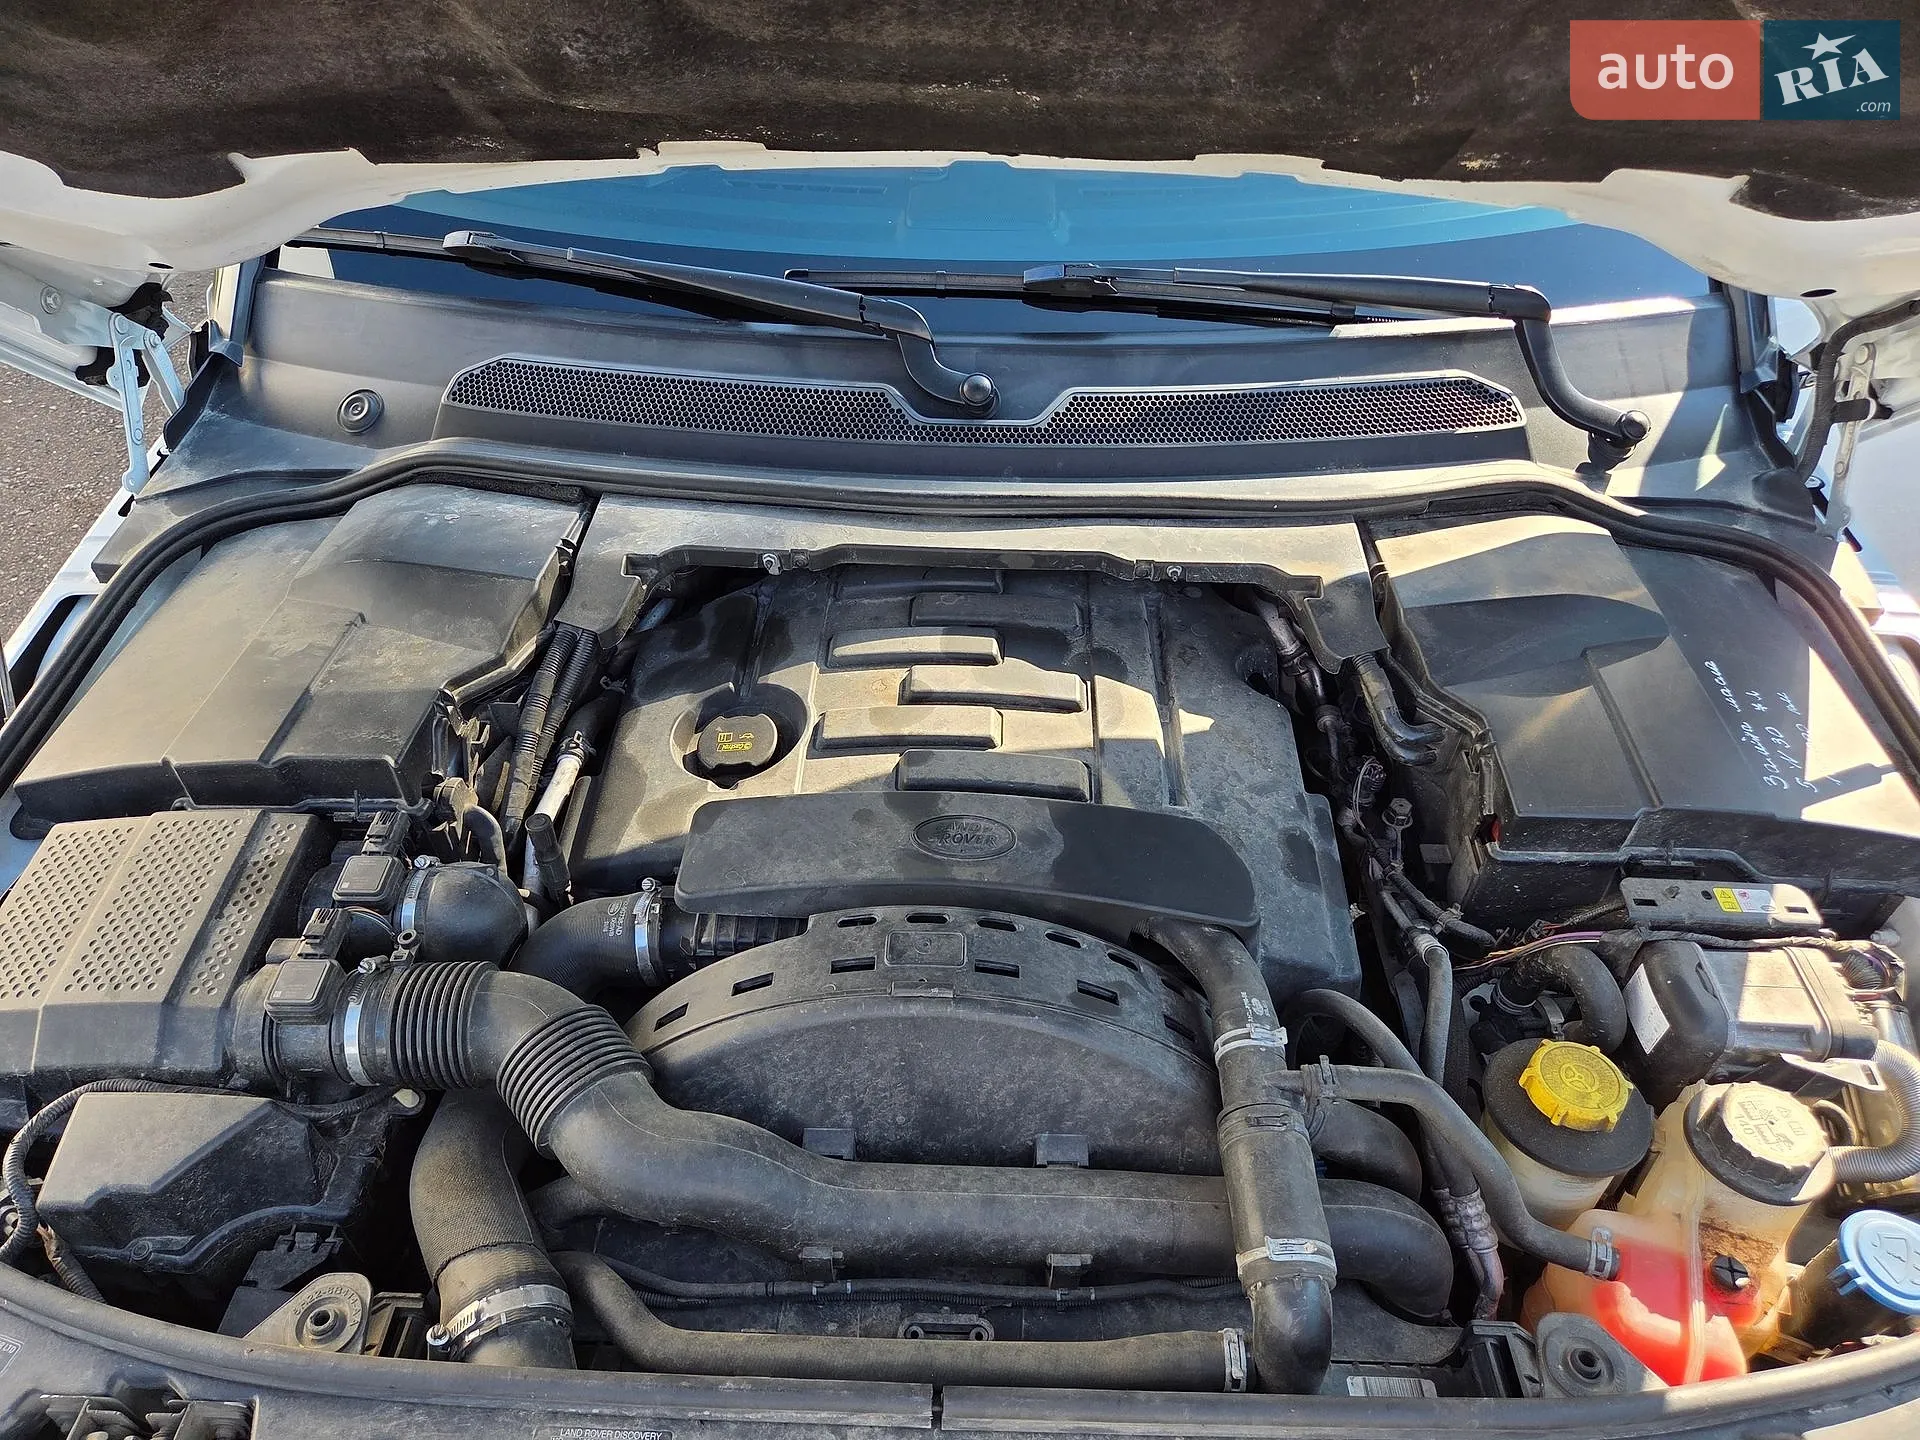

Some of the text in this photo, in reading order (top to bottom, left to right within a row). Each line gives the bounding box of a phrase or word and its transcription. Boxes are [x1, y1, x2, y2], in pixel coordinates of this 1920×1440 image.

[938, 832, 997, 846] ROVER
[560, 1428, 663, 1440] LAND ROVER DISCOVERY
